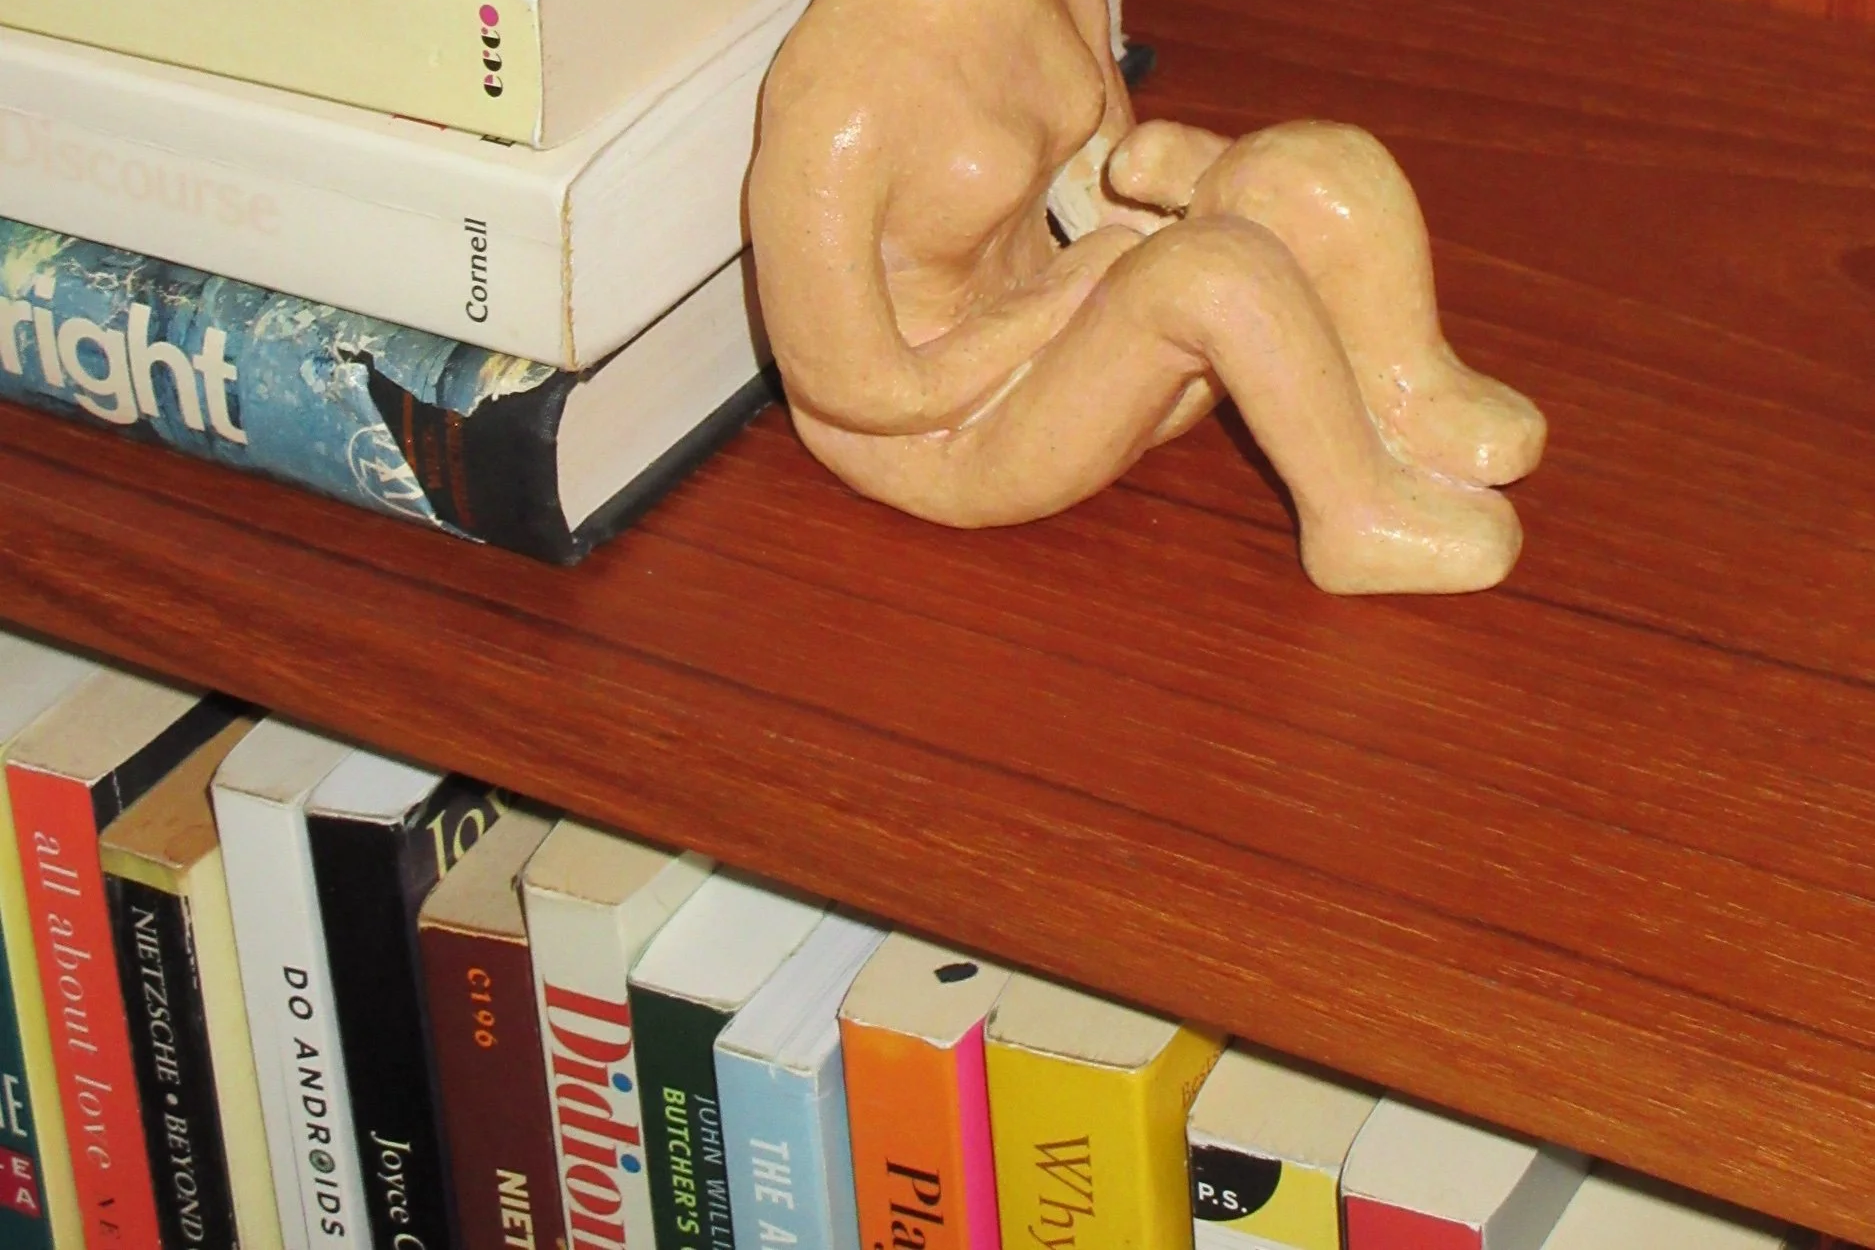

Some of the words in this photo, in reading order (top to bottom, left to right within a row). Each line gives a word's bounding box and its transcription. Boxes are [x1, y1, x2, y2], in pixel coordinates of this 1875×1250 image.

[463, 217, 489, 324] Cornell
[0, 267, 249, 446] right
[34, 831, 82, 897] all
[47, 913, 98, 1053] about
[283, 965, 314, 1021] DO
[130, 904, 182, 1086] NIETZSCHE
[163, 1112, 206, 1243] BEYOND
[544, 983, 642, 1250] Didion
[74, 1074, 113, 1170] love
[662, 1085, 701, 1236] BUTCHER'S
[370, 1130, 412, 1224] Joyce
[706, 1178, 734, 1250] WILLI
[750, 1136, 795, 1210] THE
[884, 1156, 945, 1250] Pla
[1026, 1134, 1098, 1250] Why
[1197, 1181, 1249, 1214] P.S.
